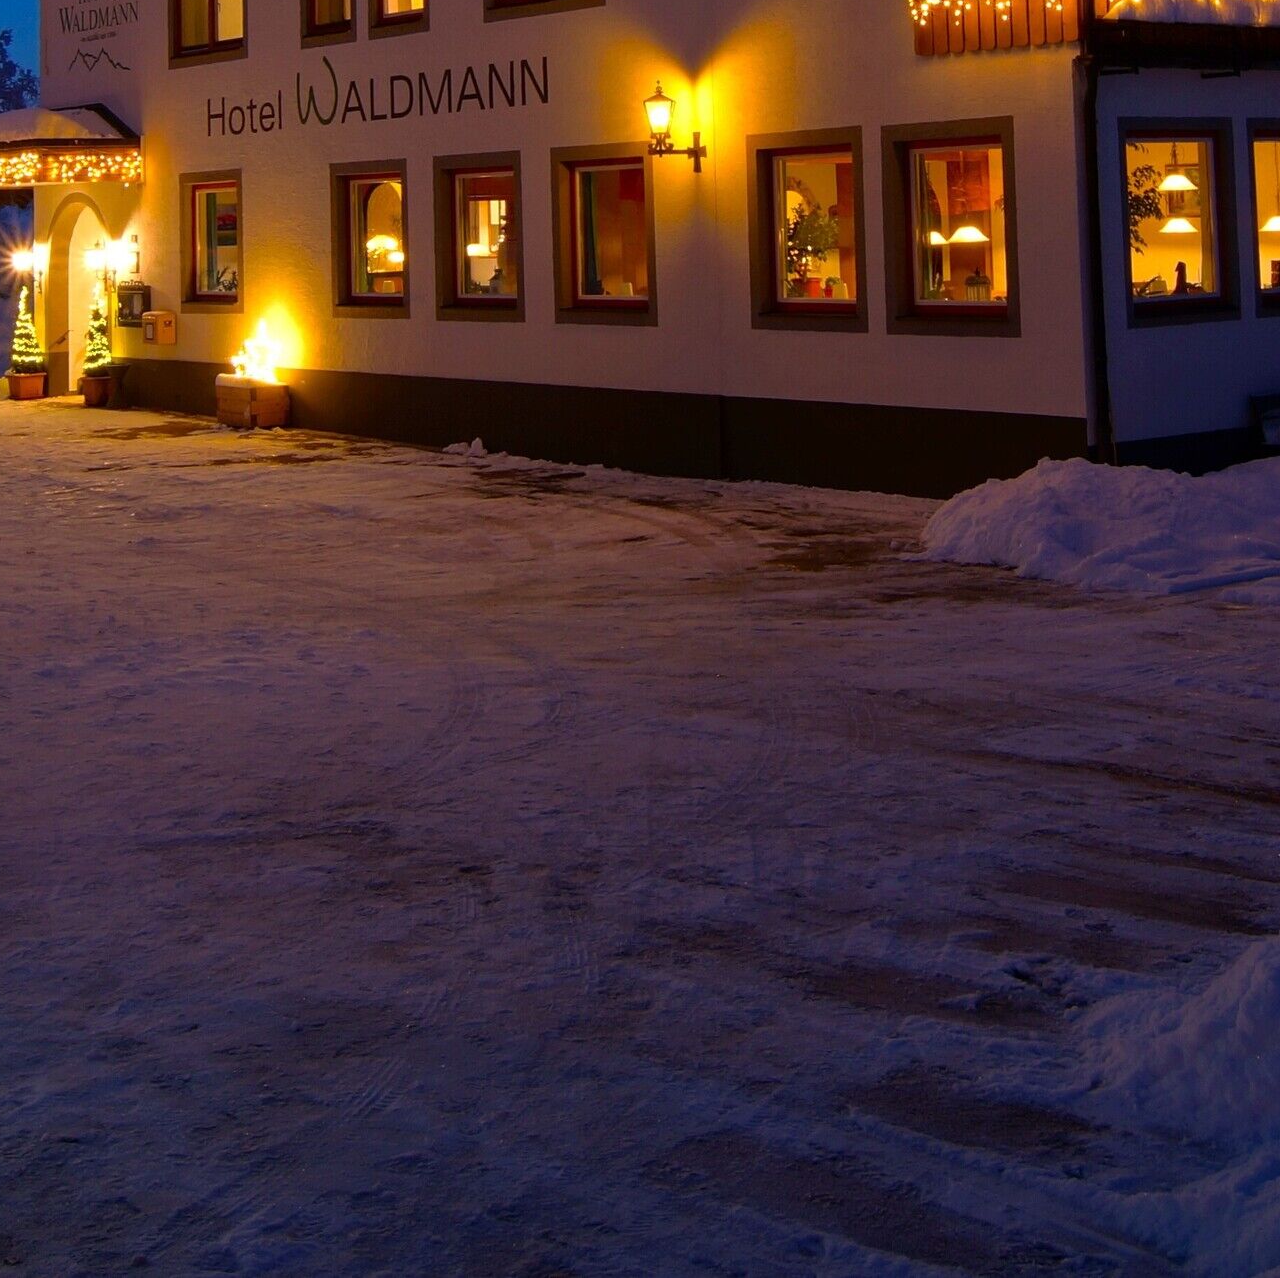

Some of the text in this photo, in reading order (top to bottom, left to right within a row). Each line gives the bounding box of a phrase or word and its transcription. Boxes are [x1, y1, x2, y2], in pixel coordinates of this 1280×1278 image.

[58, 0, 139, 34] WALDMANN
[207, 56, 549, 137] Hotel WALDMANN
